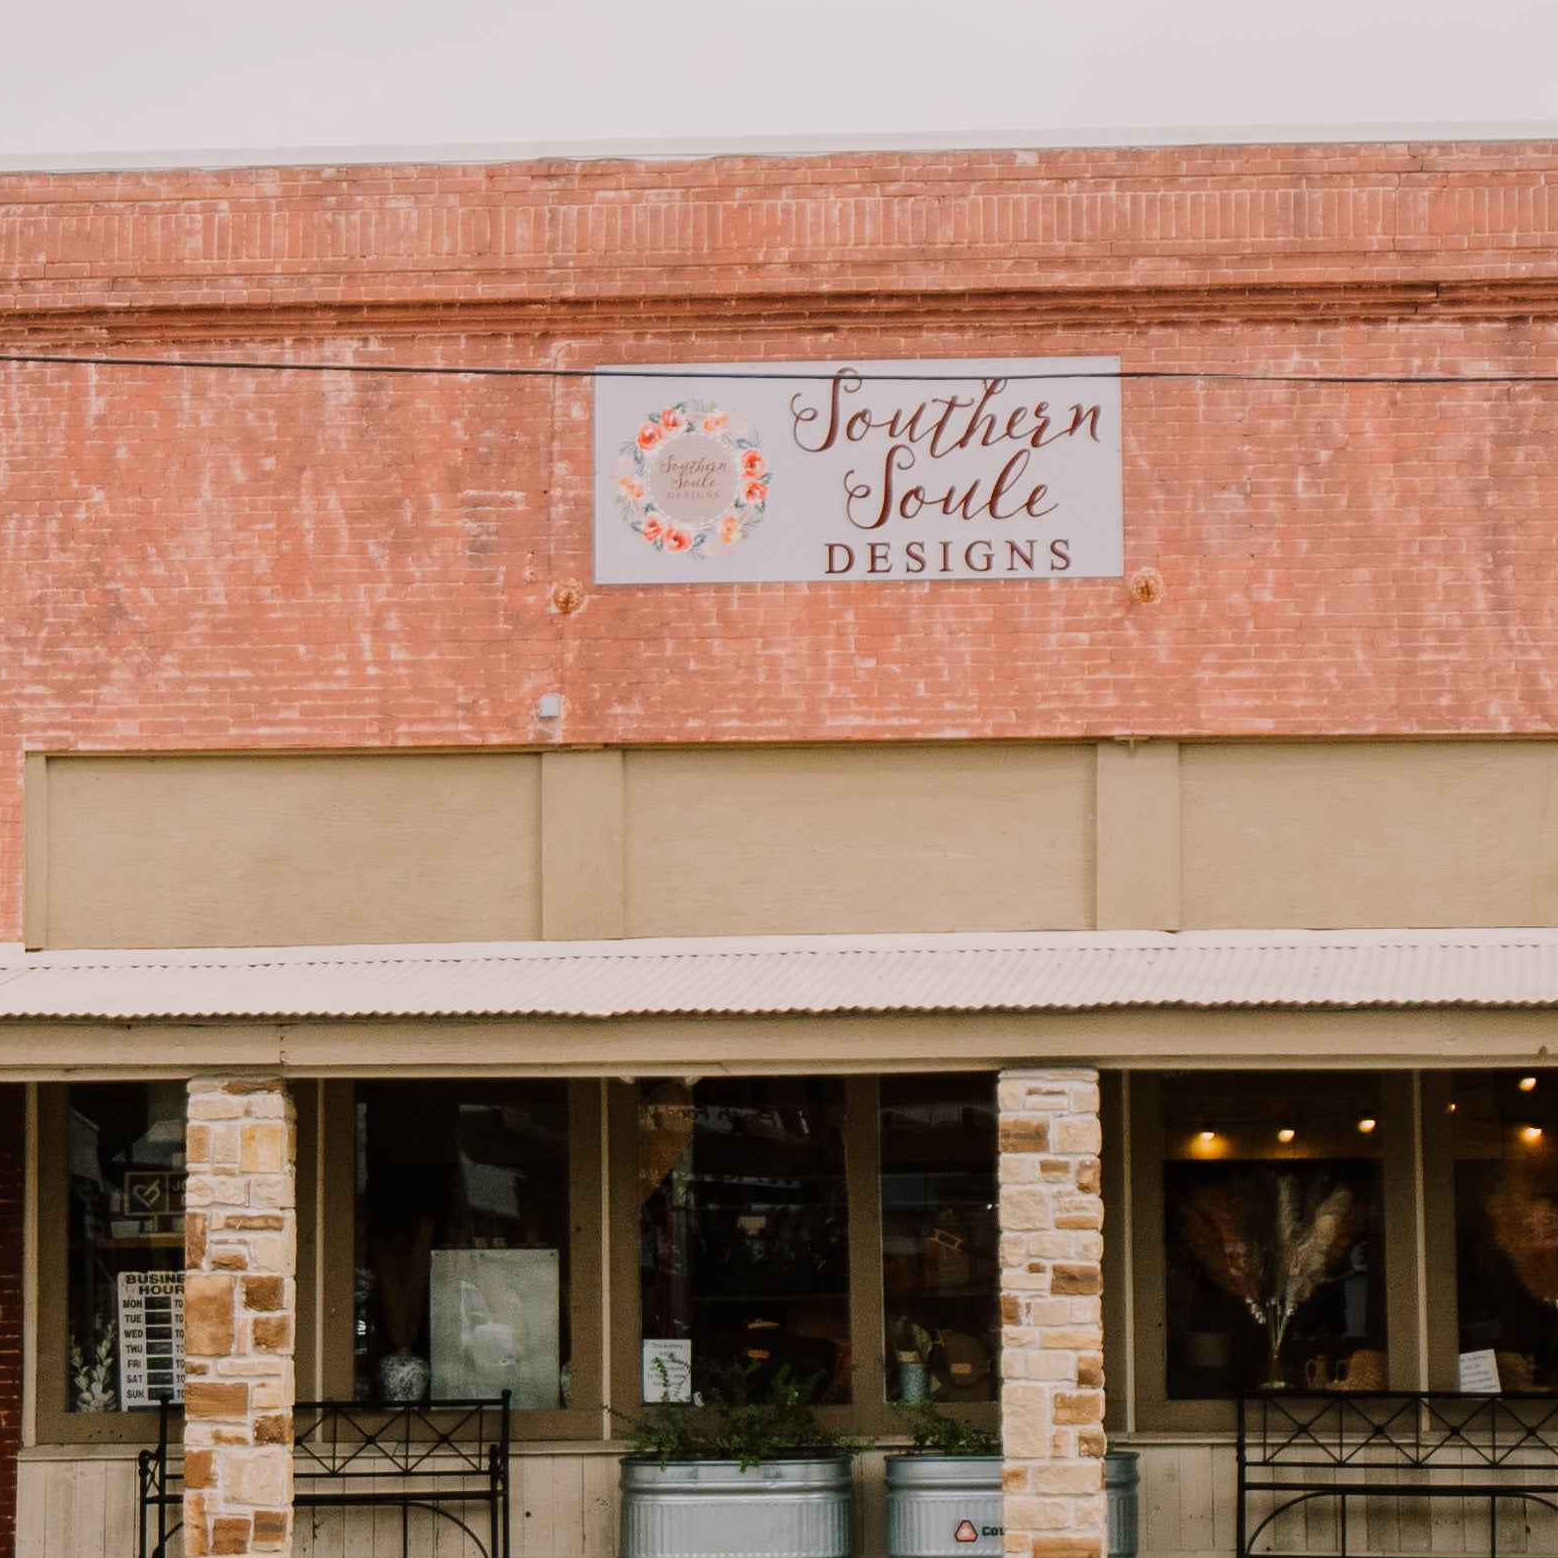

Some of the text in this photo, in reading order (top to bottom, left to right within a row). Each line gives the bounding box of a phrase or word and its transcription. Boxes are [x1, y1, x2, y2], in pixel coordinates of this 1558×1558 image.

[790, 367, 1101, 458] Southern
[660, 454, 727, 474] Southern
[671, 470, 715, 490] Soule
[843, 444, 1059, 530] Soule
[667, 491, 721, 500] DESIGNS
[824, 539, 1072, 574] DESIGNS
[125, 1273, 185, 1285] BUSINE
[138, 1285, 185, 1295] HOUR
[123, 1299, 143, 1309] MON
[124, 1314, 143, 1323] TUE
[124, 1329, 144, 1339] WED
[125, 1344, 143, 1354] THU
[127, 1359, 142, 1369] FRI
[126, 1374, 143, 1384] SAT
[126, 1389, 144, 1399] SUN
